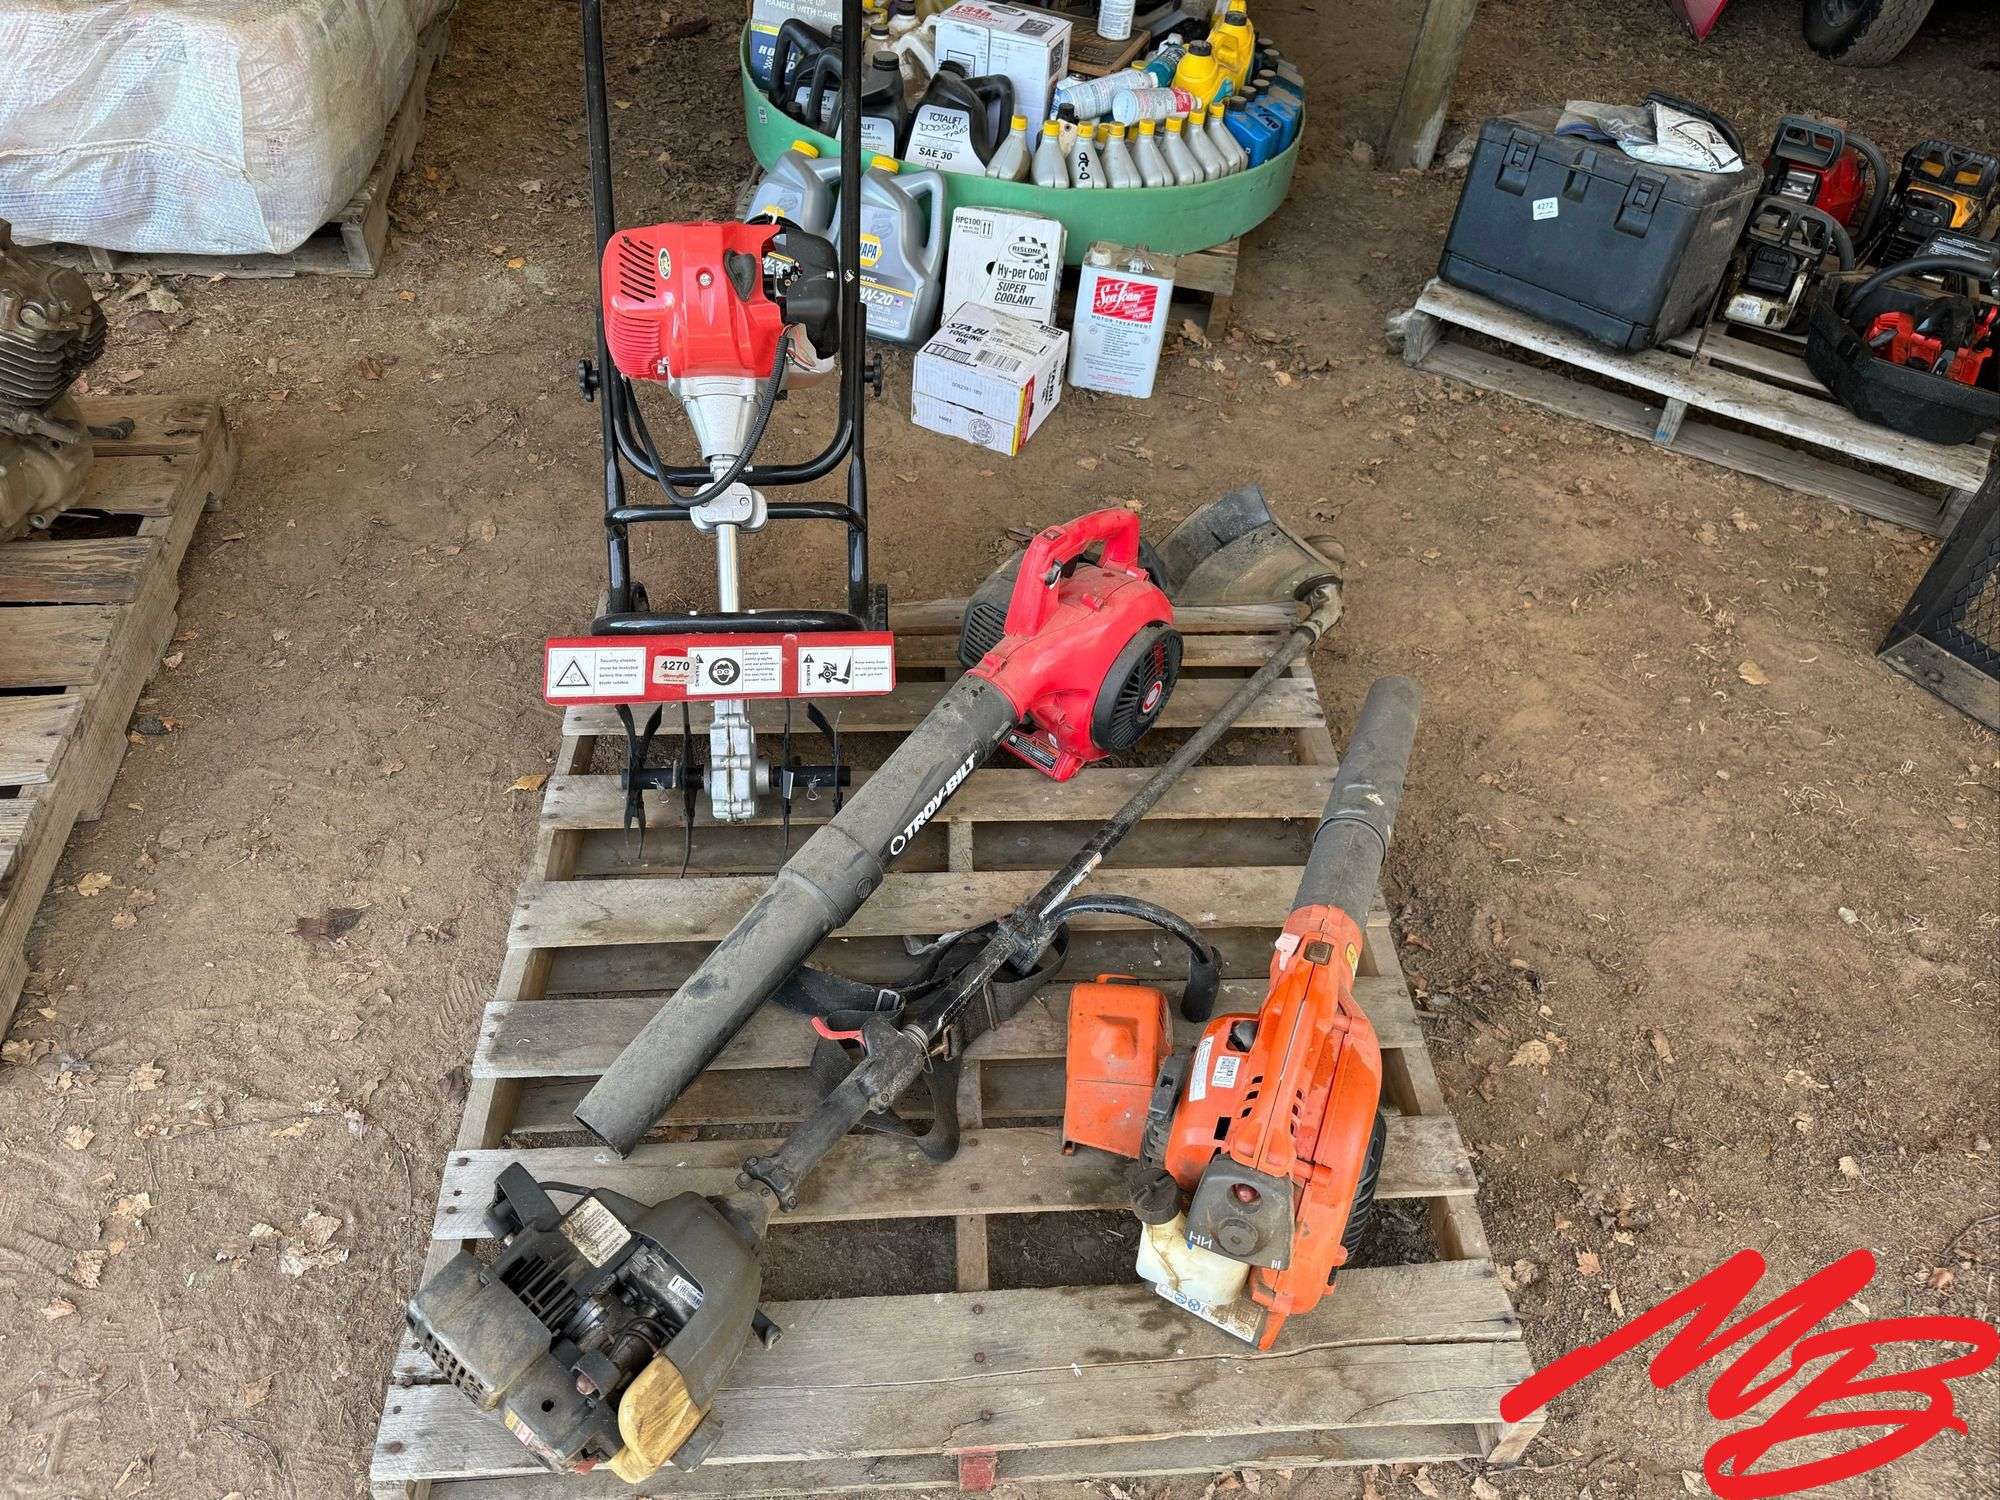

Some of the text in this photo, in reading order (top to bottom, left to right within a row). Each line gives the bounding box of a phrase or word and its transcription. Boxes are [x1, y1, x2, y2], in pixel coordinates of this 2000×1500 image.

[758, 44, 797, 61] ROL
[929, 112, 963, 125] TOTALIFT
[918, 147, 952, 161] SAE 30
[955, 215, 980, 225] HPC100
[997, 263, 1049, 281] Hy-per Cool
[996, 281, 1027, 294] SUPER
[860, 287, 894, 306] W-20
[994, 292, 1035, 306] COOLANT
[947, 322, 989, 336] STA-BI
[1115, 319, 1152, 330] TREATMENT
[948, 329, 983, 342] FOGGING
[955, 337, 968, 345] OIL
[661, 660, 691, 671] 4270
[903, 752, 975, 840] TROY-BILT
